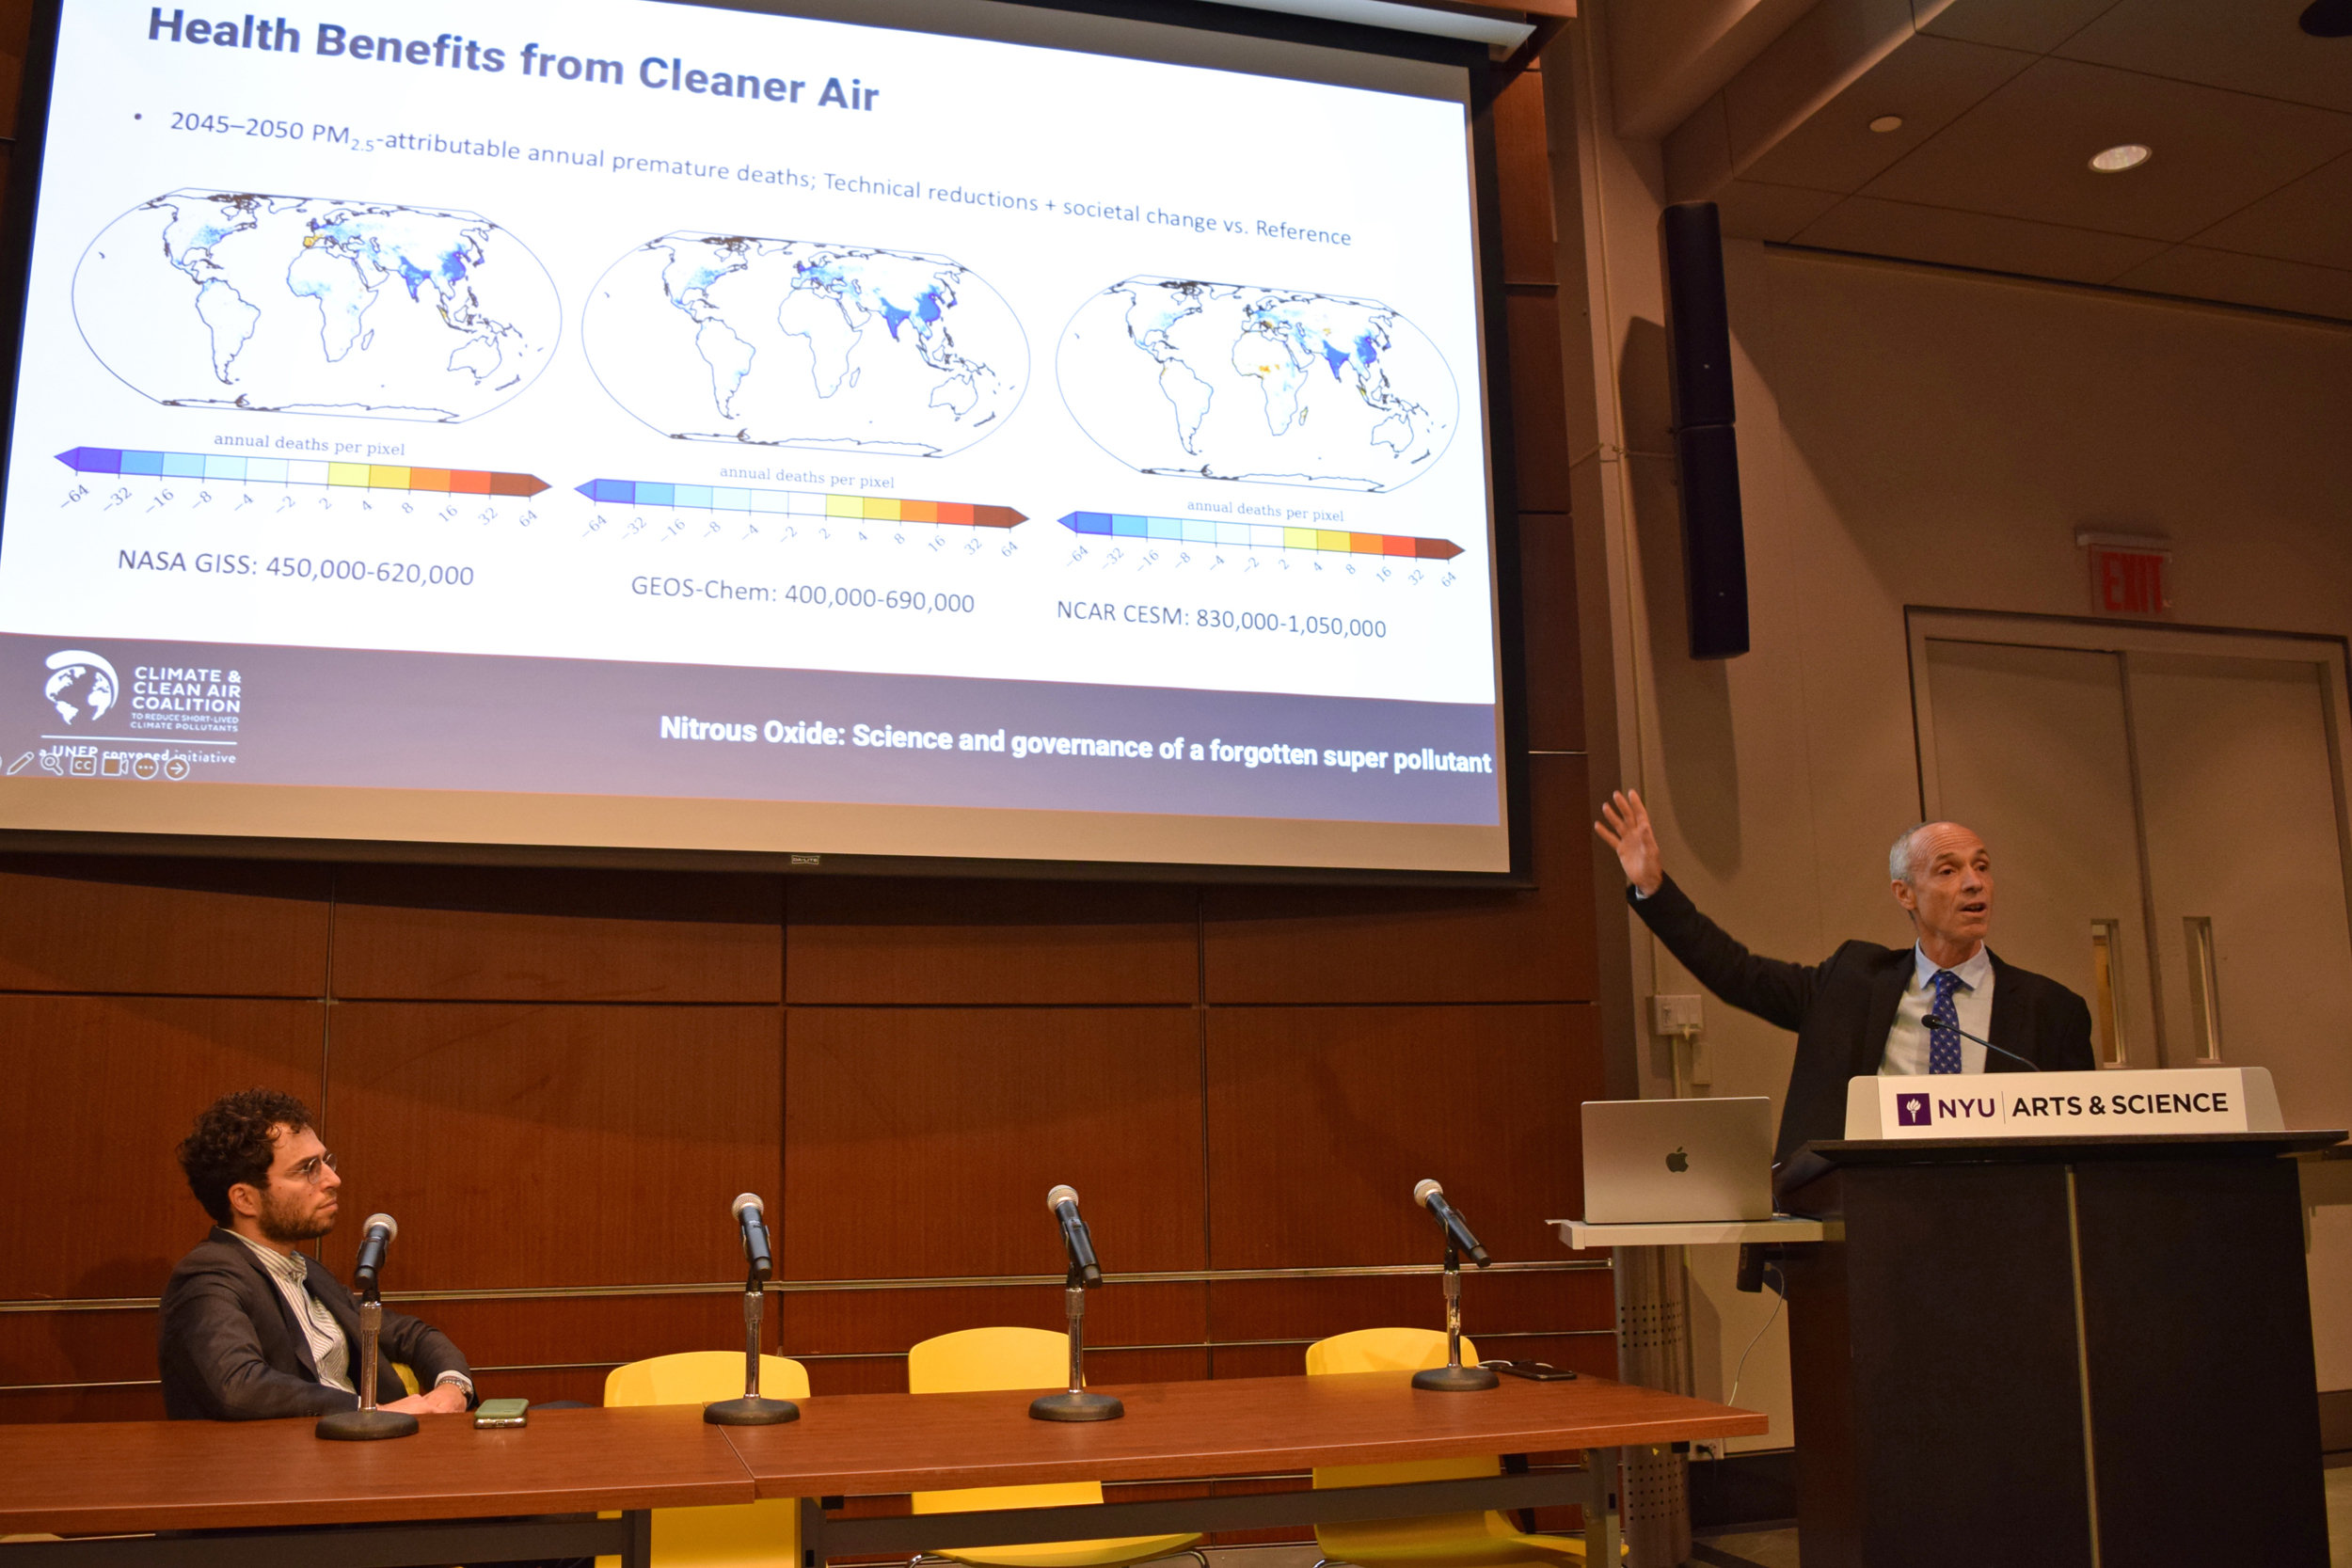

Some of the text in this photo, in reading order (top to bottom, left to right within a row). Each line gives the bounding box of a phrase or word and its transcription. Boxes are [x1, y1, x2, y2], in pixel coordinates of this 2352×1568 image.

[147, 6, 880, 111] Health Benefits from Cleaner Air
[527, 146, 605, 167] annual
[612, 152, 729, 181] premature
[737, 164, 816, 191] deaths;
[824, 172, 920, 198] Technical
[929, 184, 1038, 211] reductions
[1045, 200, 1056, 212] +
[1063, 200, 1140, 222] societal
[1146, 207, 1216, 232] change
[1223, 218, 1248, 234] vs.
[1257, 219, 1351, 245] Reference
[215, 435, 405, 456] annual deaths per pixel
[720, 467, 895, 489] annual deaths per pixel
[318, 498, 332, 510] 2
[361, 499, 373, 512] 4
[401, 502, 414, 515] 8
[438, 505, 458, 523] 16
[478, 507, 498, 526] 32
[518, 510, 538, 527] 64
[1187, 501, 1344, 522] annual deaths per pixel
[818, 528, 831, 539] 2
[858, 531, 868, 542] 4
[894, 533, 905, 545] 8
[929, 536, 946, 553] 16
[964, 538, 982, 556] 32
[1001, 541, 1018, 558] 64
[119, 549, 474, 587] NASA GISS: 450,000-620,000
[1279, 559, 1290, 570] 2
[1313, 562, 1324, 572] 4
[1345, 563, 1357, 575] 8
[1375, 566, 1391, 582] 16
[1407, 569, 1424, 585] 32
[1441, 571, 1457, 587] 64
[631, 576, 975, 614] GEOS-Chem: 400,000-690,000
[2101, 551, 2164, 613] EXIT
[1057, 601, 1386, 639] NCAR CESM: 830,000-1,050,000
[135, 666, 241, 683] CLIMATE &
[134, 681, 241, 698] CLEAN AIR
[132, 696, 240, 713] COALITION
[130, 721, 238, 733] CLIMATE POLLUTANTS
[145, 713, 180, 721] REDUCE
[182, 715, 239, 724] SHORT-LIVED
[39, 749, 47, 757] a
[52, 745, 98, 757] UNEP
[174, 750, 236, 764] initiative
[660, 716, 1492, 774] Nitrous Oxide: Science and governance of a forgotten super pollutant
[1938, 1092, 2228, 1118] NYU ARTS & SCIENCE
